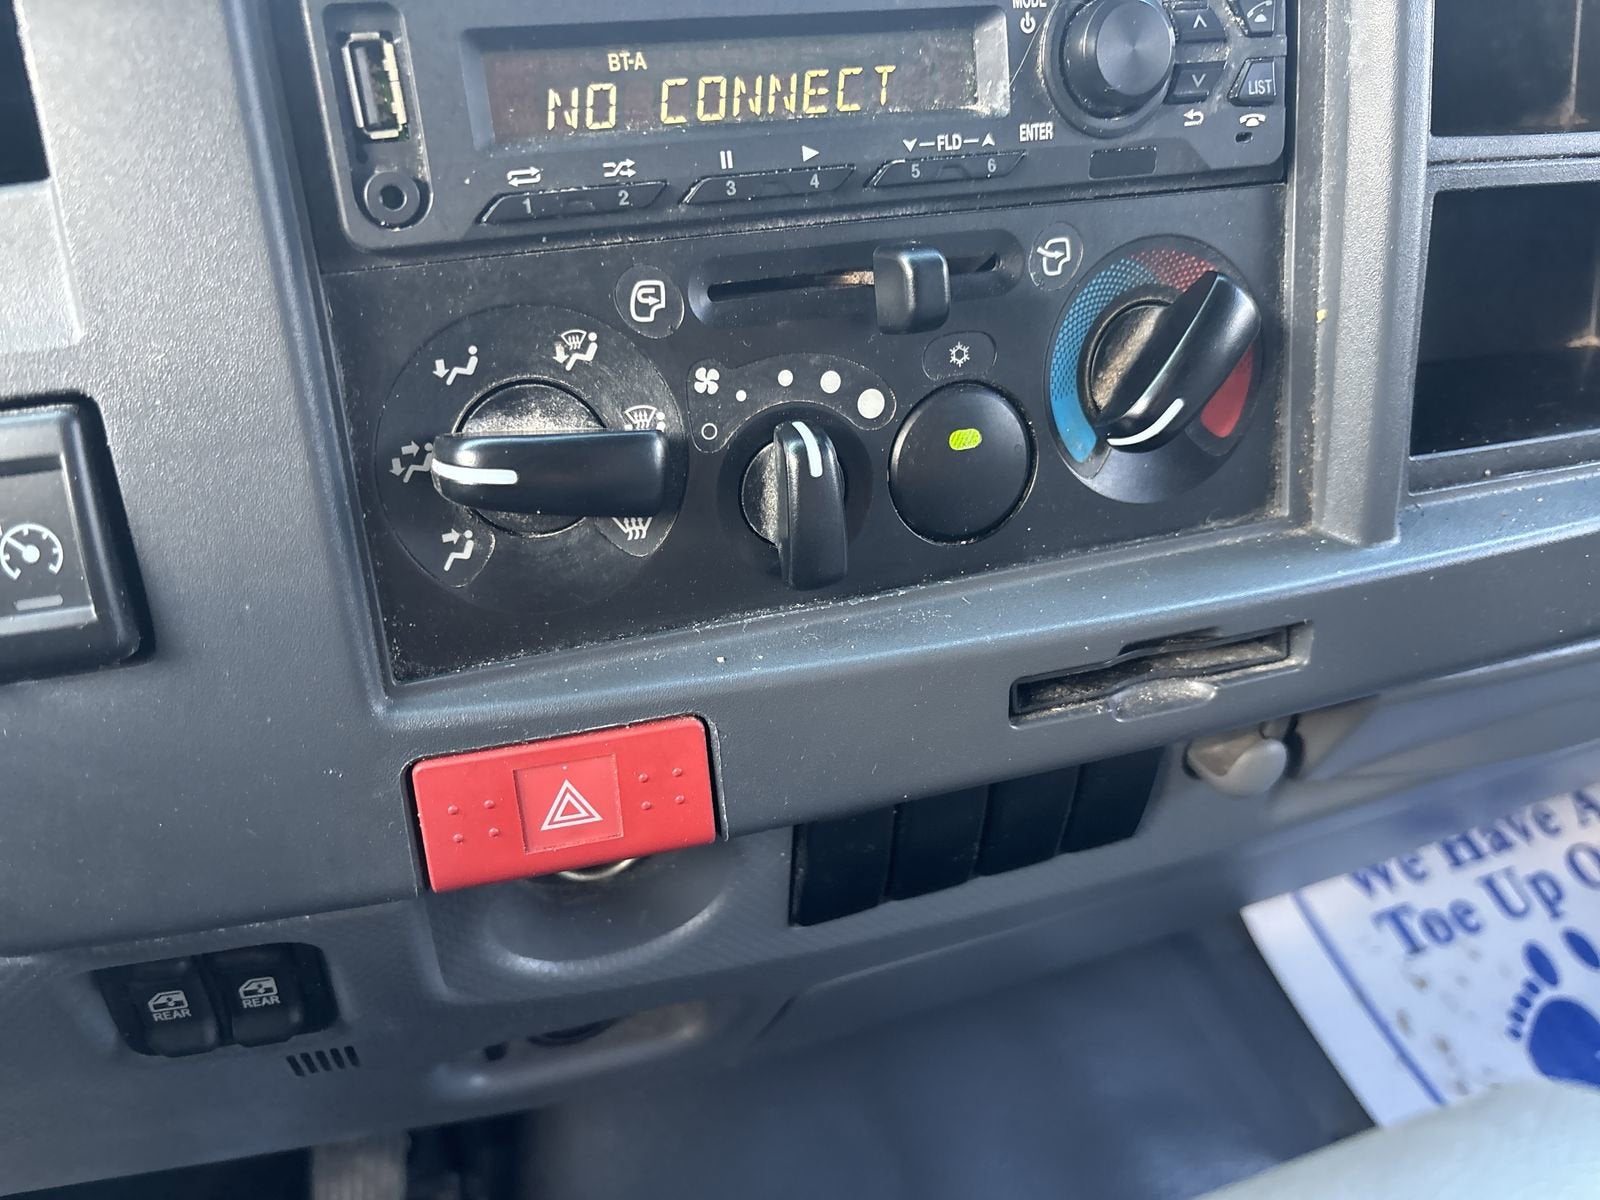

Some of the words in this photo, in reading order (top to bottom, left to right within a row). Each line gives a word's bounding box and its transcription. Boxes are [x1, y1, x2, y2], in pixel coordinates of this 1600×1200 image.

[608, 51, 647, 72] BT-A
[547, 82, 617, 130] NO
[660, 65, 897, 124] CONNECT
[1247, 80, 1273, 97] LIST
[1019, 122, 1054, 142] ENTER
[936, 134, 962, 152] FLD
[910, 162, 921, 180] 5
[987, 157, 998, 174] 6
[726, 179, 738, 197] 3
[809, 171, 820, 189] 4
[522, 198, 533, 214] 1
[618, 189, 630, 206] 2
[1372, 900, 1482, 955] Toe
[1477, 866, 1565, 920] Up
[242, 995, 281, 1009] REAR
[152, 1008, 192, 1022] REAR
